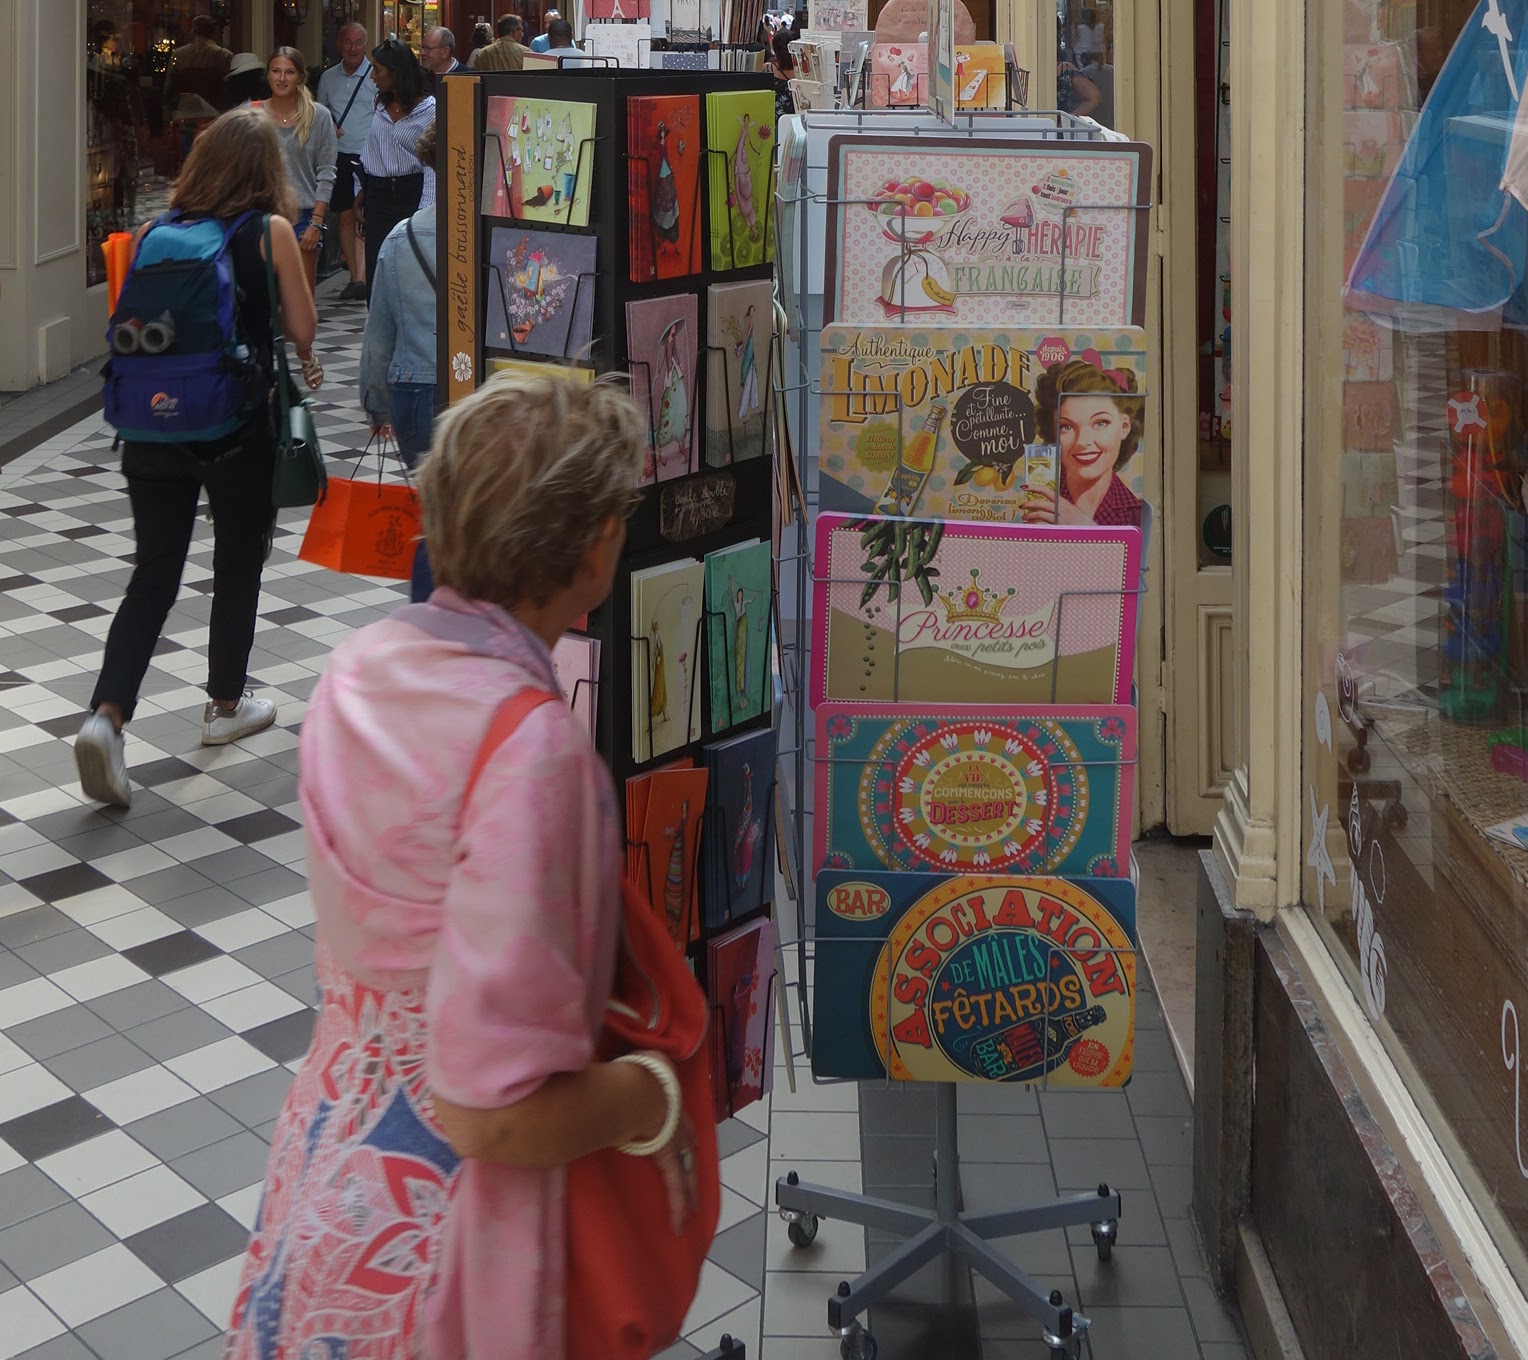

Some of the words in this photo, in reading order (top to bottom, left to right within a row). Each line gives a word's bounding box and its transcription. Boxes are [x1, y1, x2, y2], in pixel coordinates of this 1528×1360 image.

[935, 217, 1012, 254] Happy
[448, 270, 476, 343] gaëlle
[837, 332, 935, 366] Authentique
[1041, 352, 1065, 362] 1906
[829, 343, 1032, 424] LIMONADE
[972, 385, 1012, 410] Fine
[966, 402, 977, 417] et
[898, 610, 1048, 644] Princesse
[972, 640, 1015, 658] petits
[1014, 639, 1048, 658] pois
[965, 773, 984, 782] VIE
[933, 787, 1013, 802] COMMENÇONS
[929, 800, 1017, 825] DESSERT
[832, 888, 887, 916] BAR
[892, 890, 1128, 1051] ASSOCIATION
[952, 959, 975, 986] DE
[972, 933, 1047, 991] MÂLES
